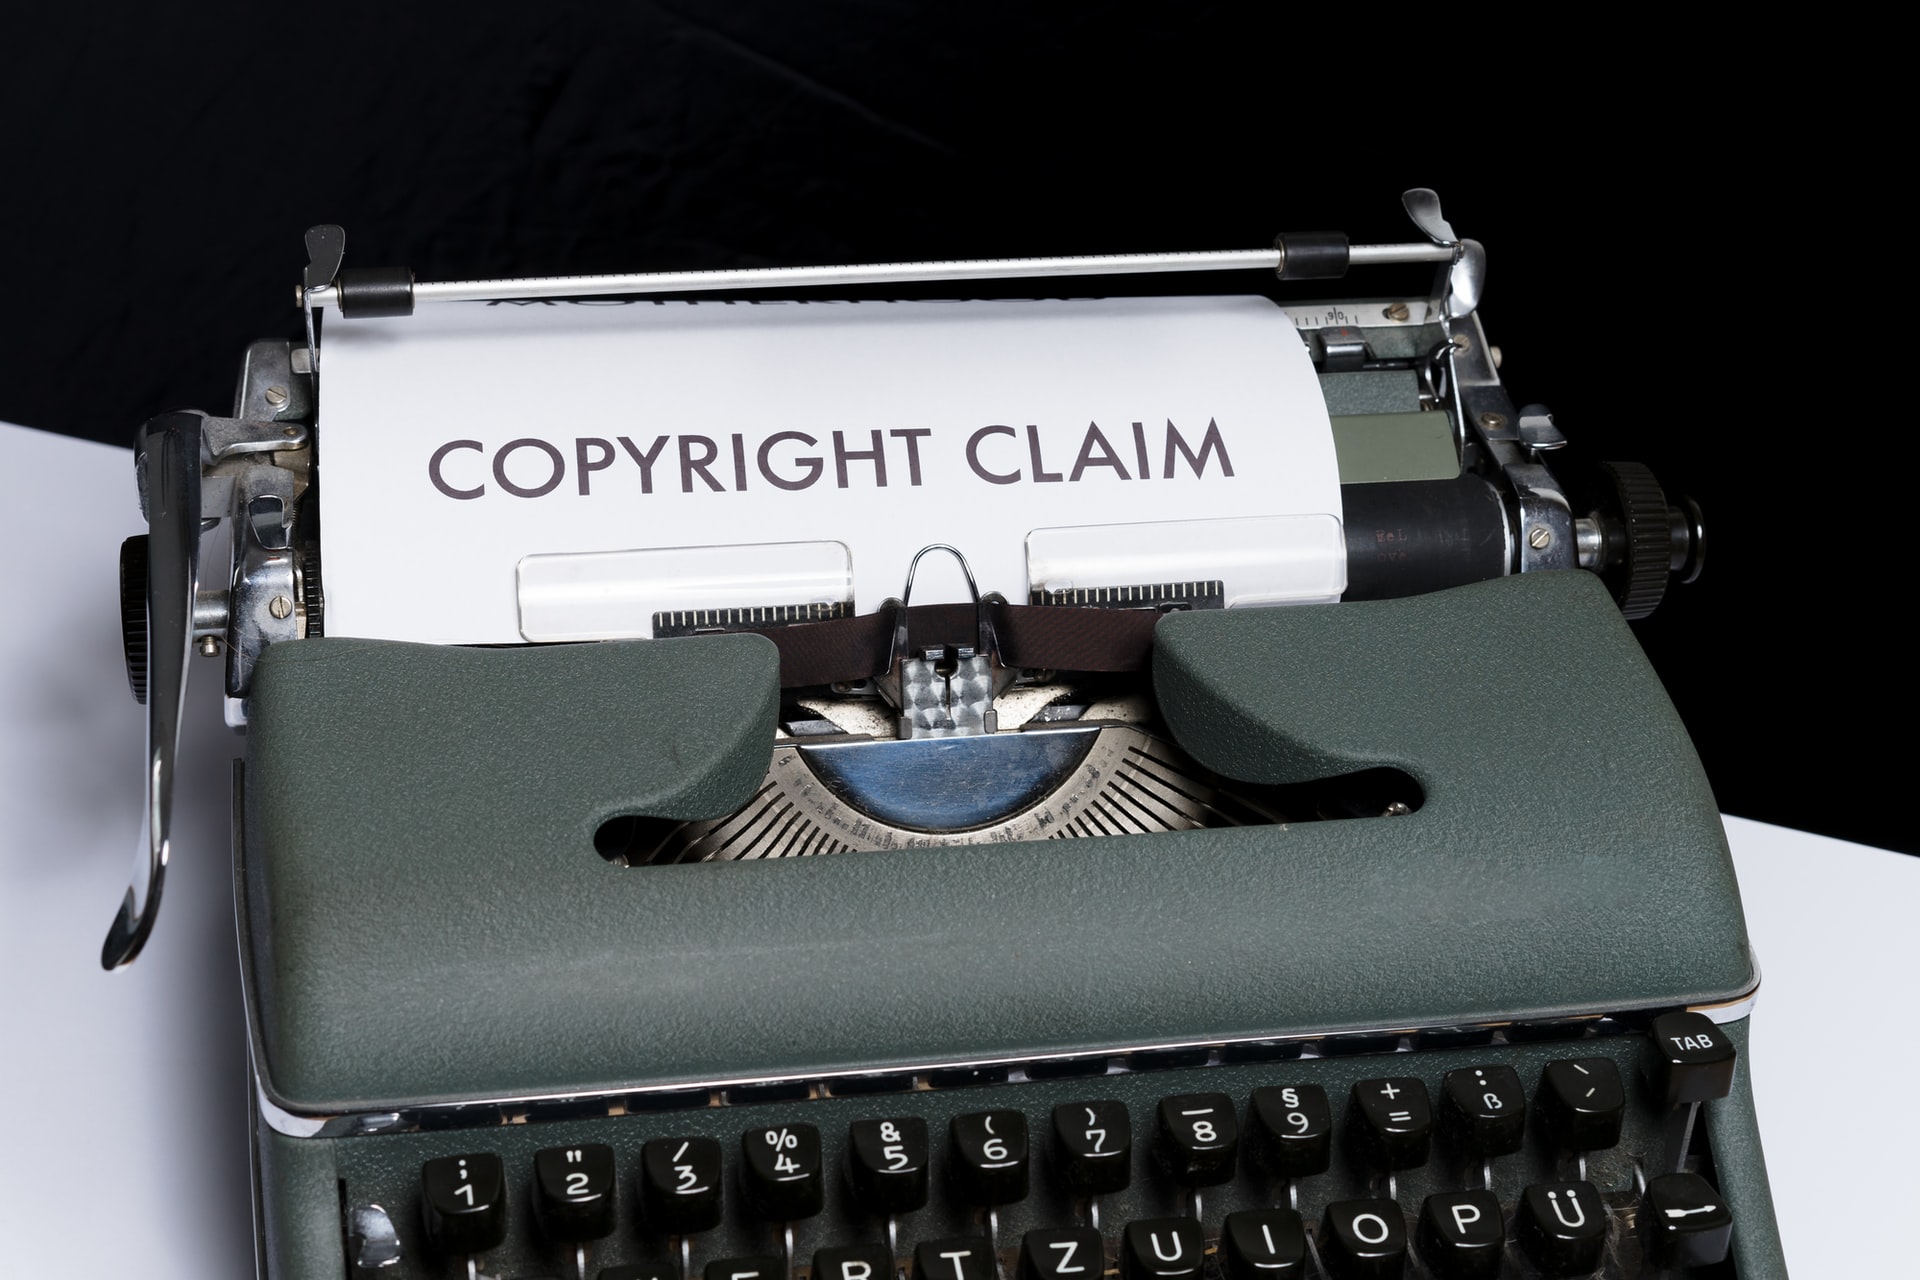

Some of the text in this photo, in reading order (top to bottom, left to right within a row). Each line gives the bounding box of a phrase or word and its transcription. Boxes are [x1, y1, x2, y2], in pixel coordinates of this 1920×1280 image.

[429, 418, 1234, 499] COPYRIGHT CLAIM
[1670, 1035, 1713, 1050] TAB
[1282, 1088, 1299, 1108] §
[1381, 1083, 1400, 1099] +
[1287, 1113, 1308, 1133] 9
[1389, 1112, 1411, 1121] =
[766, 1129, 797, 1151] %
[881, 1122, 901, 1142] &
[1086, 1129, 1105, 1152] 7
[1193, 1121, 1216, 1141] 8
[884, 1146, 908, 1169] 5
[984, 1139, 1007, 1159] 6
[775, 1154, 800, 1173] 4
[566, 1173, 588, 1194] 2
[674, 1165, 698, 1191] 3
[455, 1185, 473, 1205] 1
[1452, 1205, 1480, 1233] P
[1548, 1190, 1584, 1227] Ü
[1263, 1225, 1275, 1254] I
[1353, 1214, 1388, 1243] O
[1050, 1242, 1084, 1273] Z
[1151, 1232, 1182, 1261] U
[940, 1251, 970, 1280] T
